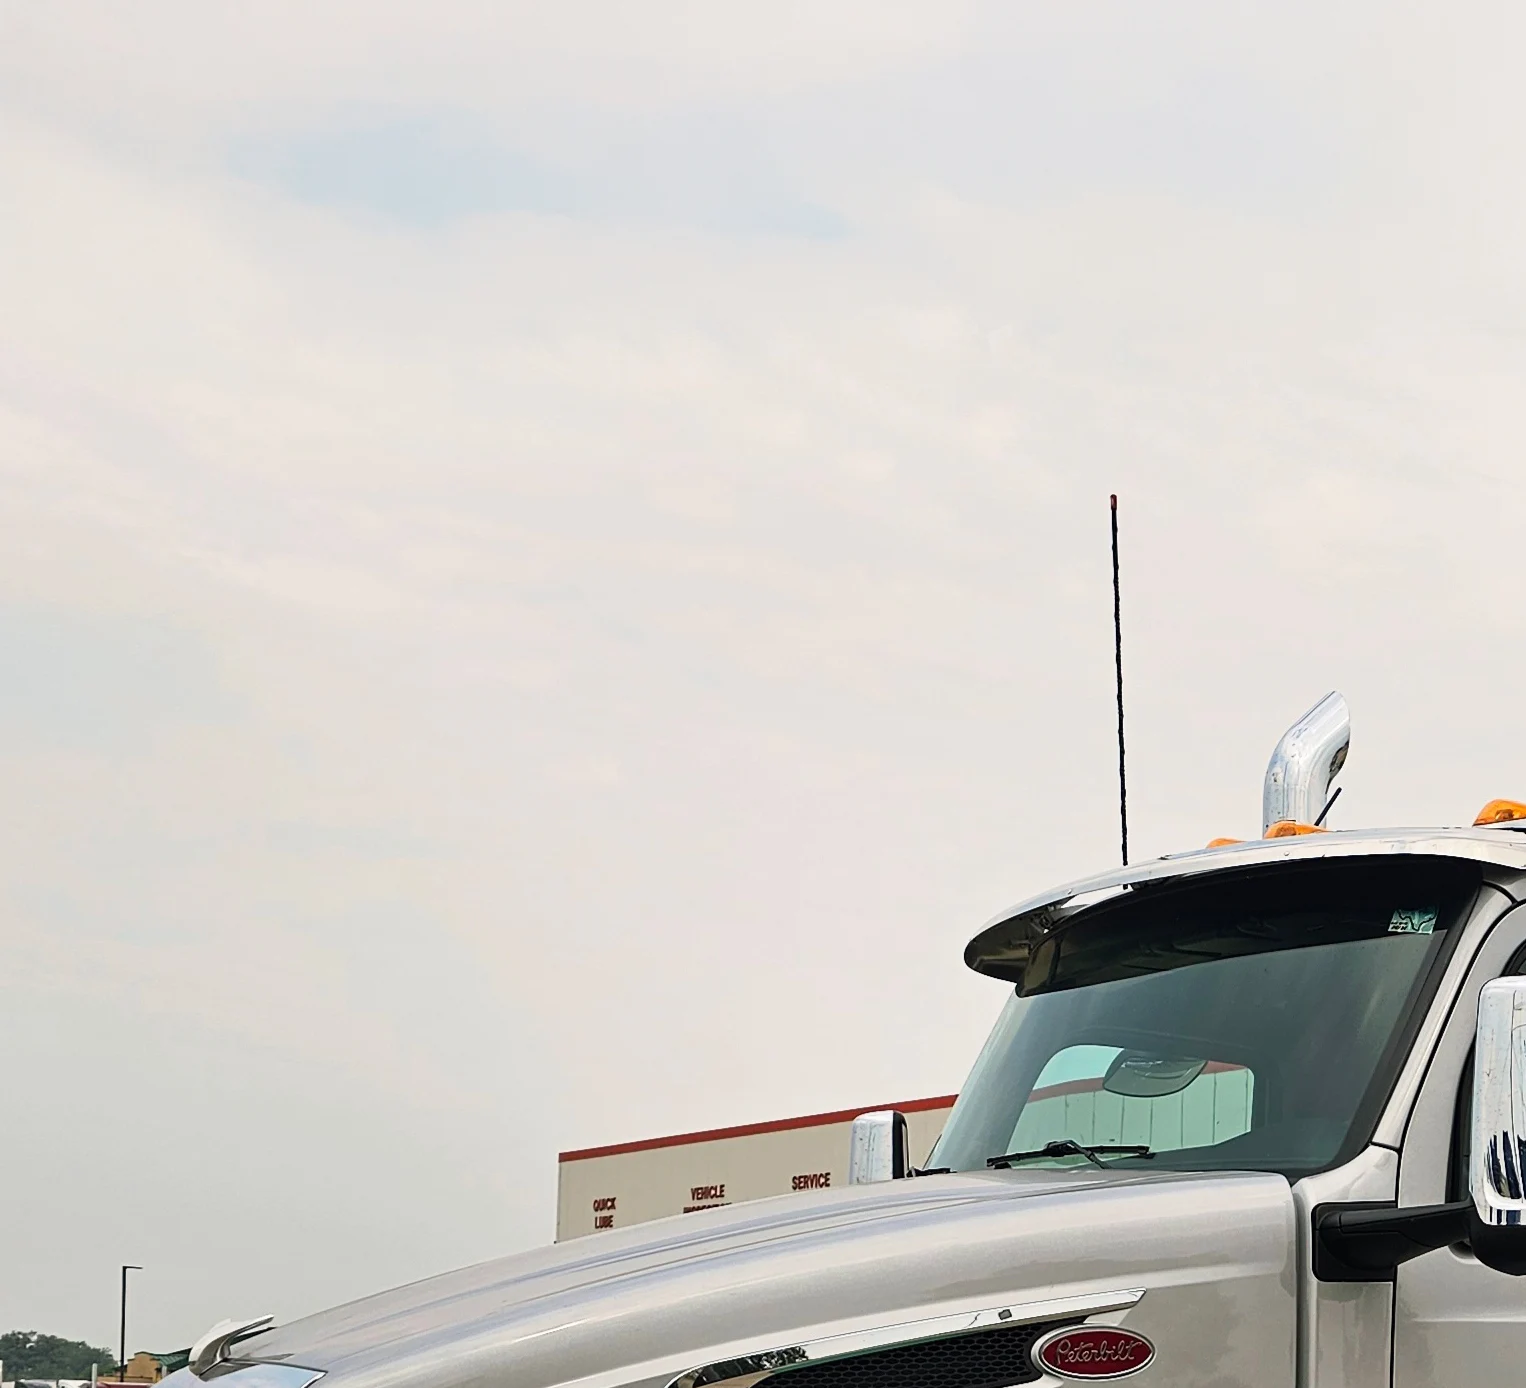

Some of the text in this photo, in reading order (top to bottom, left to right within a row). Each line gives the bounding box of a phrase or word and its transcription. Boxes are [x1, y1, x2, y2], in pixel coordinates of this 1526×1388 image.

[792, 1172, 831, 1190] SERVICE
[691, 1184, 725, 1200] VEHICLE
[593, 1197, 616, 1212] QUICK
[595, 1215, 613, 1229] LUBE
[1056, 1339, 1142, 1366] Peterbilt
